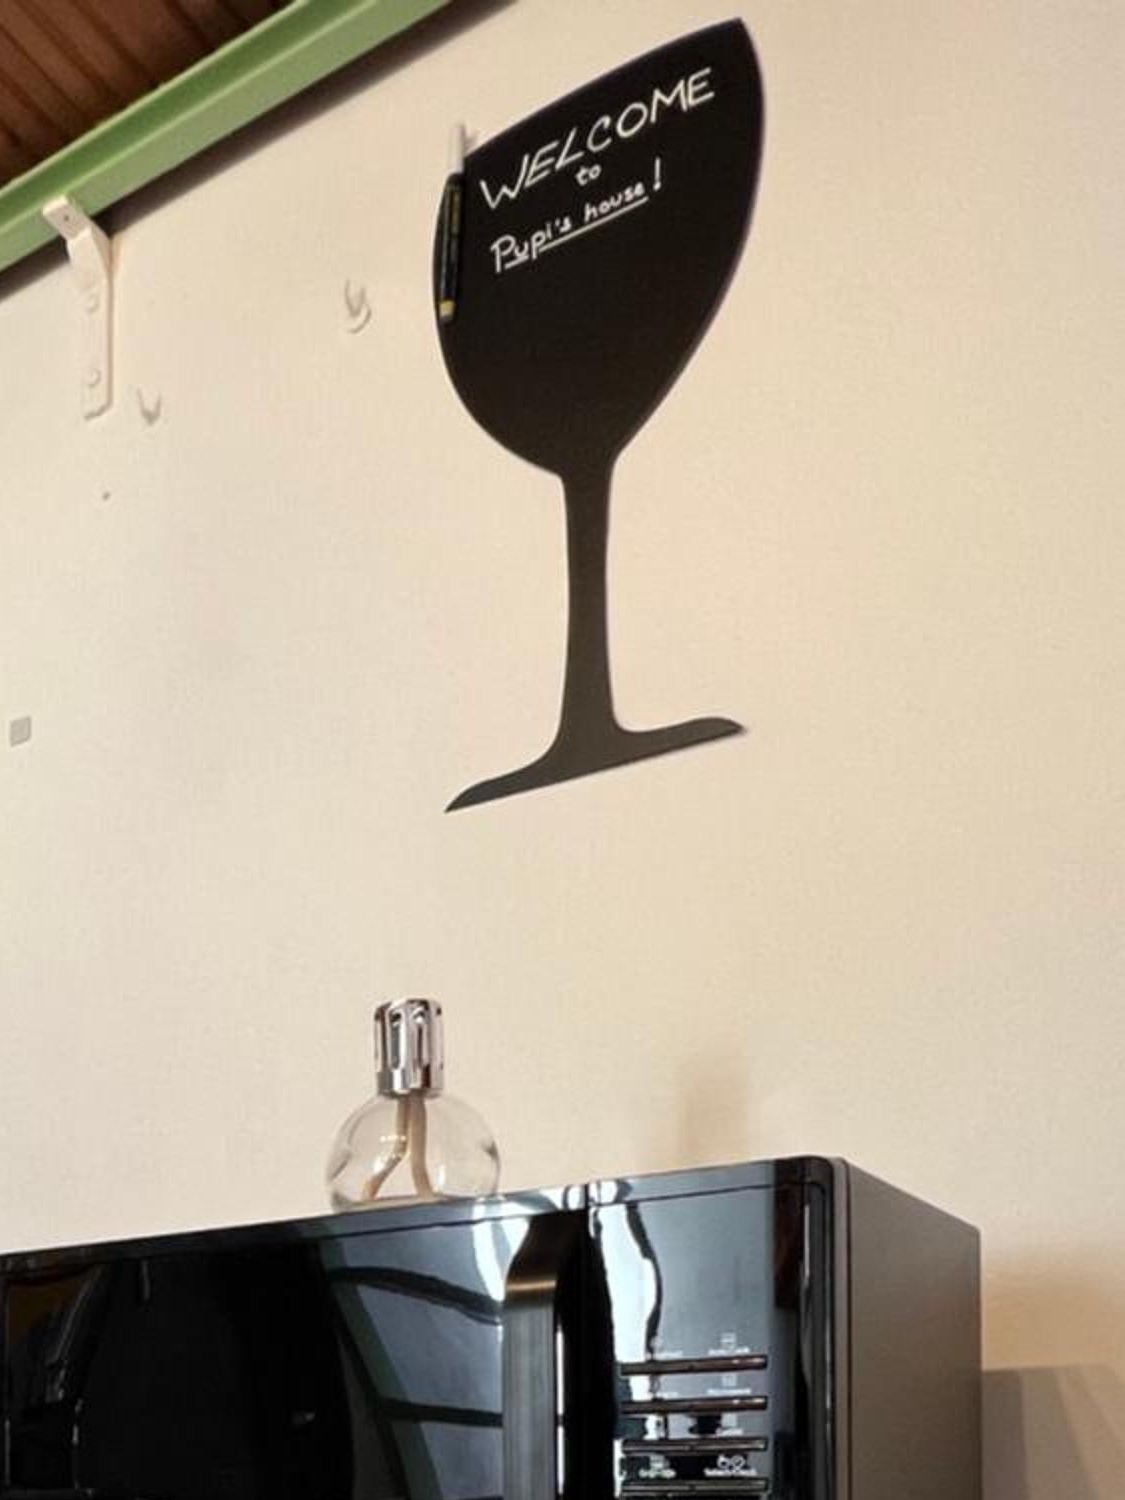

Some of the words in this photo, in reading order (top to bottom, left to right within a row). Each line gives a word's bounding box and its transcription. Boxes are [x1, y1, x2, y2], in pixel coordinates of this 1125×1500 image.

[479, 67, 715, 209] WELCOME
[575, 163, 602, 186] to
[490, 216, 572, 273] Pupi's
